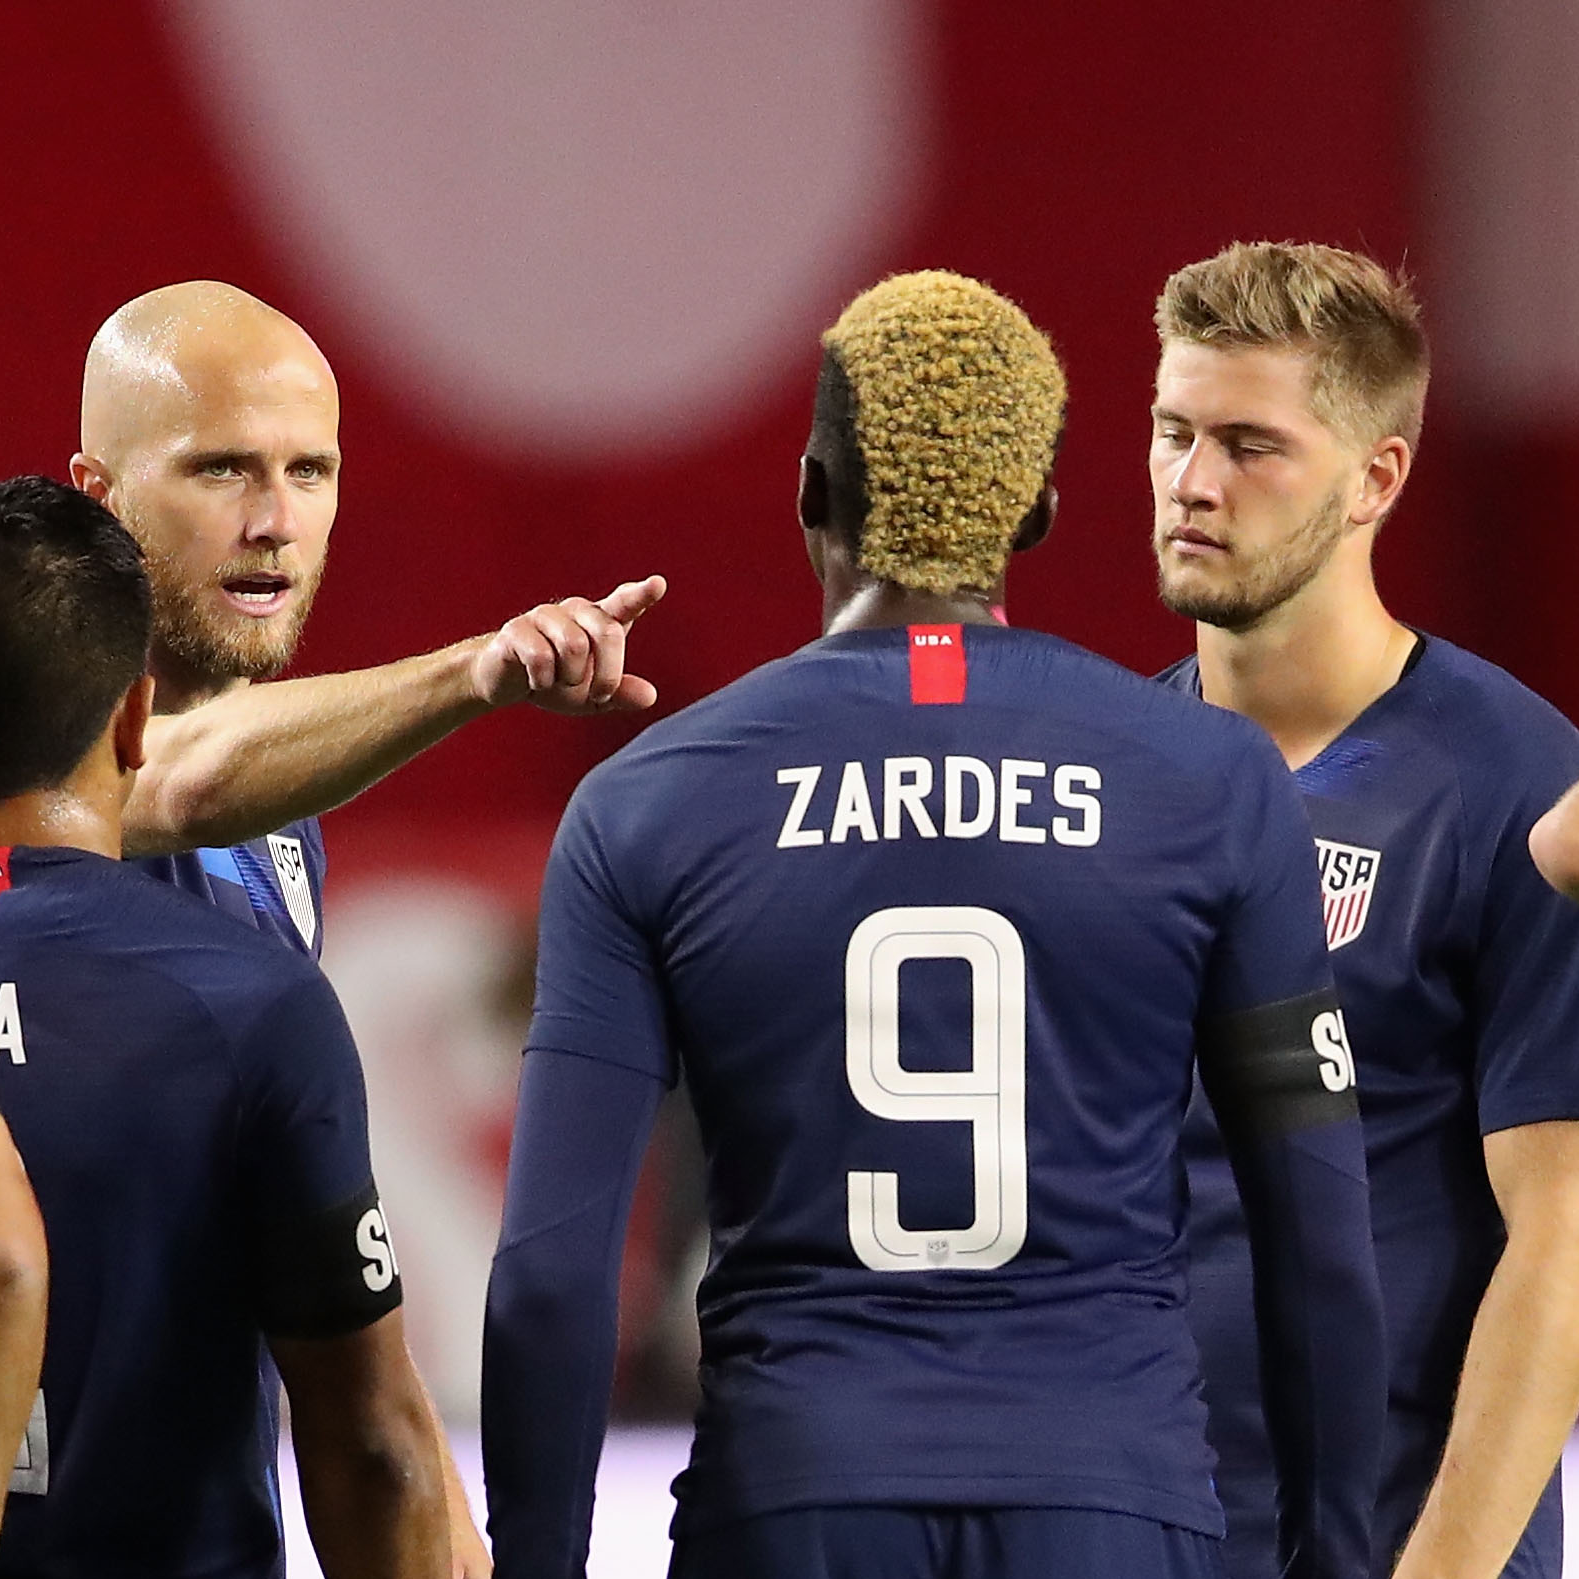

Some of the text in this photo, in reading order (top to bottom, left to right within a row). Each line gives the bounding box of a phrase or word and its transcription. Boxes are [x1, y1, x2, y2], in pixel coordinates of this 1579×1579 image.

[914, 634, 952, 646] USA
[776, 755, 1102, 849] ZARDES
[270, 841, 302, 882] USA
[845, 906, 1028, 1272] 9
